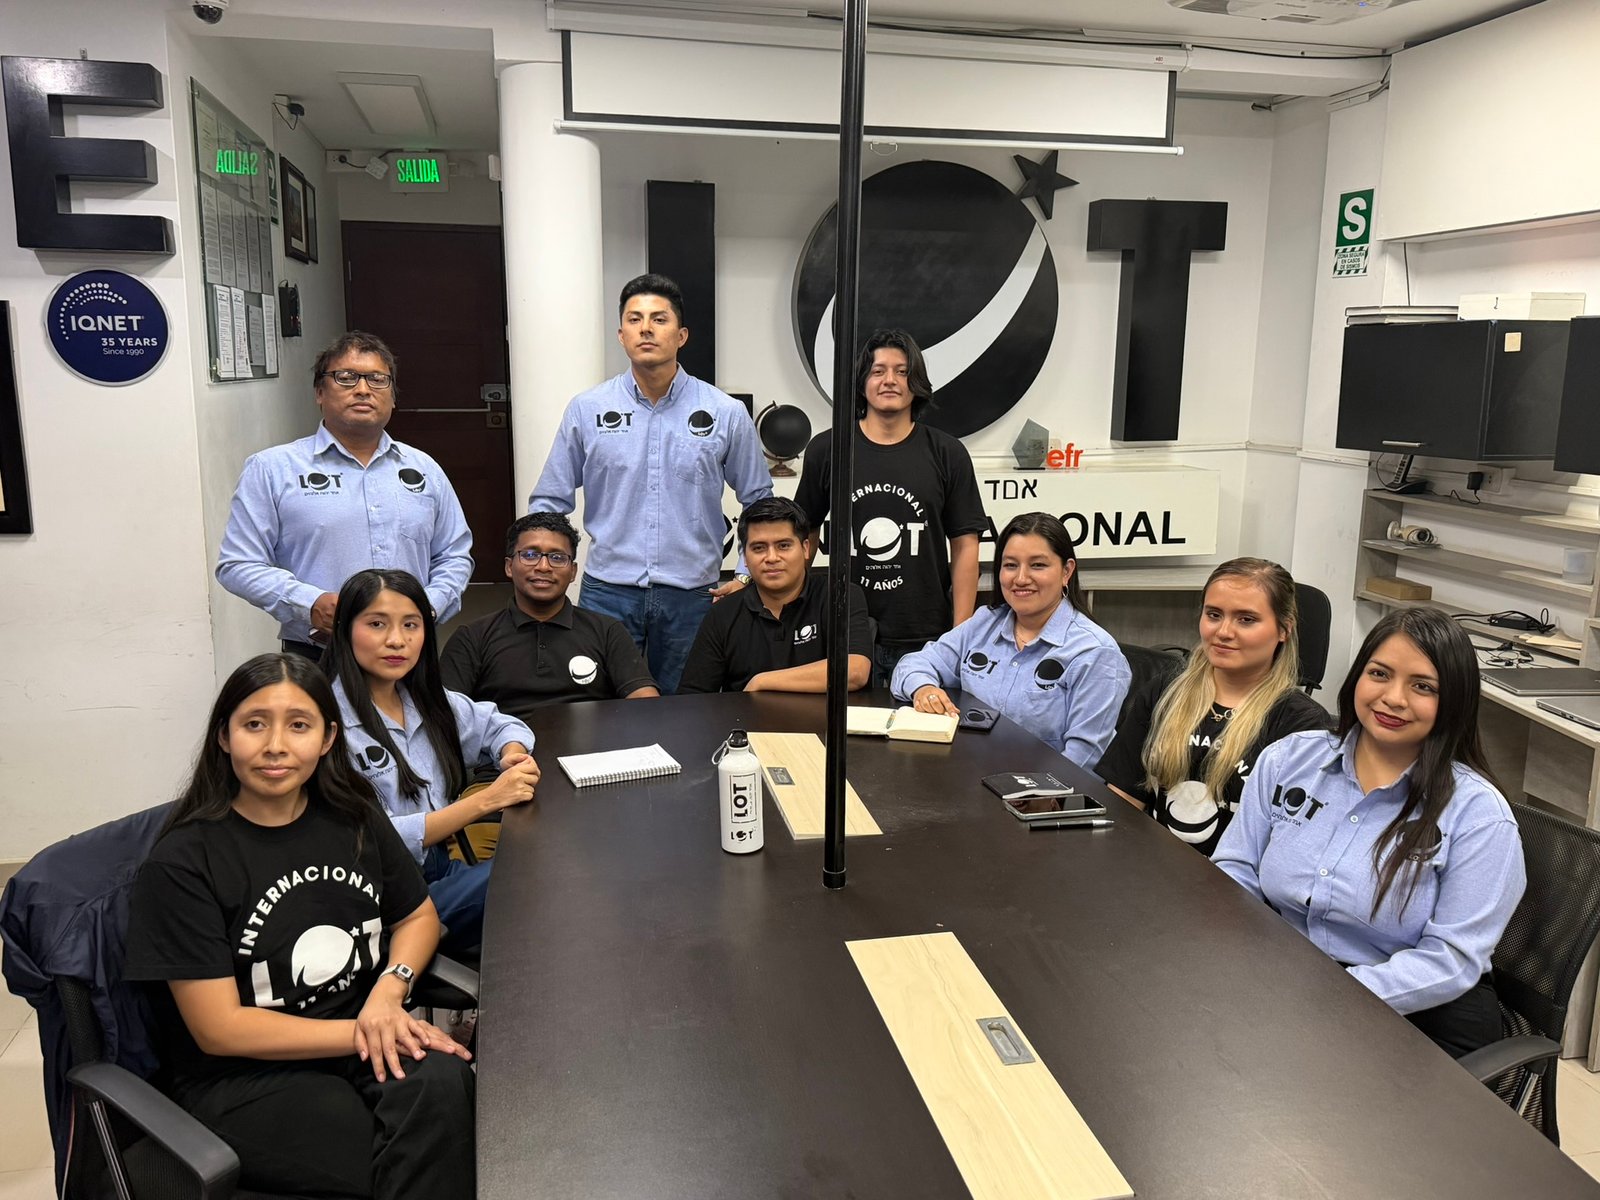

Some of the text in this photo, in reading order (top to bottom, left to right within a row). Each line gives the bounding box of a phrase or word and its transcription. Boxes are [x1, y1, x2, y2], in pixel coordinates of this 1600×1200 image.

[1, 56, 176, 255] E
[396, 158, 440, 183] SALIDA
[1342, 197, 1367, 240] S
[70, 315, 141, 331] IQNET
[101, 337, 158, 346] 35 YEARS
[103, 347, 145, 356] Since 1990
[596, 410, 633, 429] LOT
[1046, 443, 1083, 468] efr
[299, 472, 342, 491] LOT
[851, 483, 924, 517] ERNACIONAL
[860, 576, 903, 591] 11 AÑOS
[356, 746, 390, 771] LO
[733, 783, 748, 817] LOT
[1271, 784, 1324, 820] LOT
[731, 831, 753, 842] LOT
